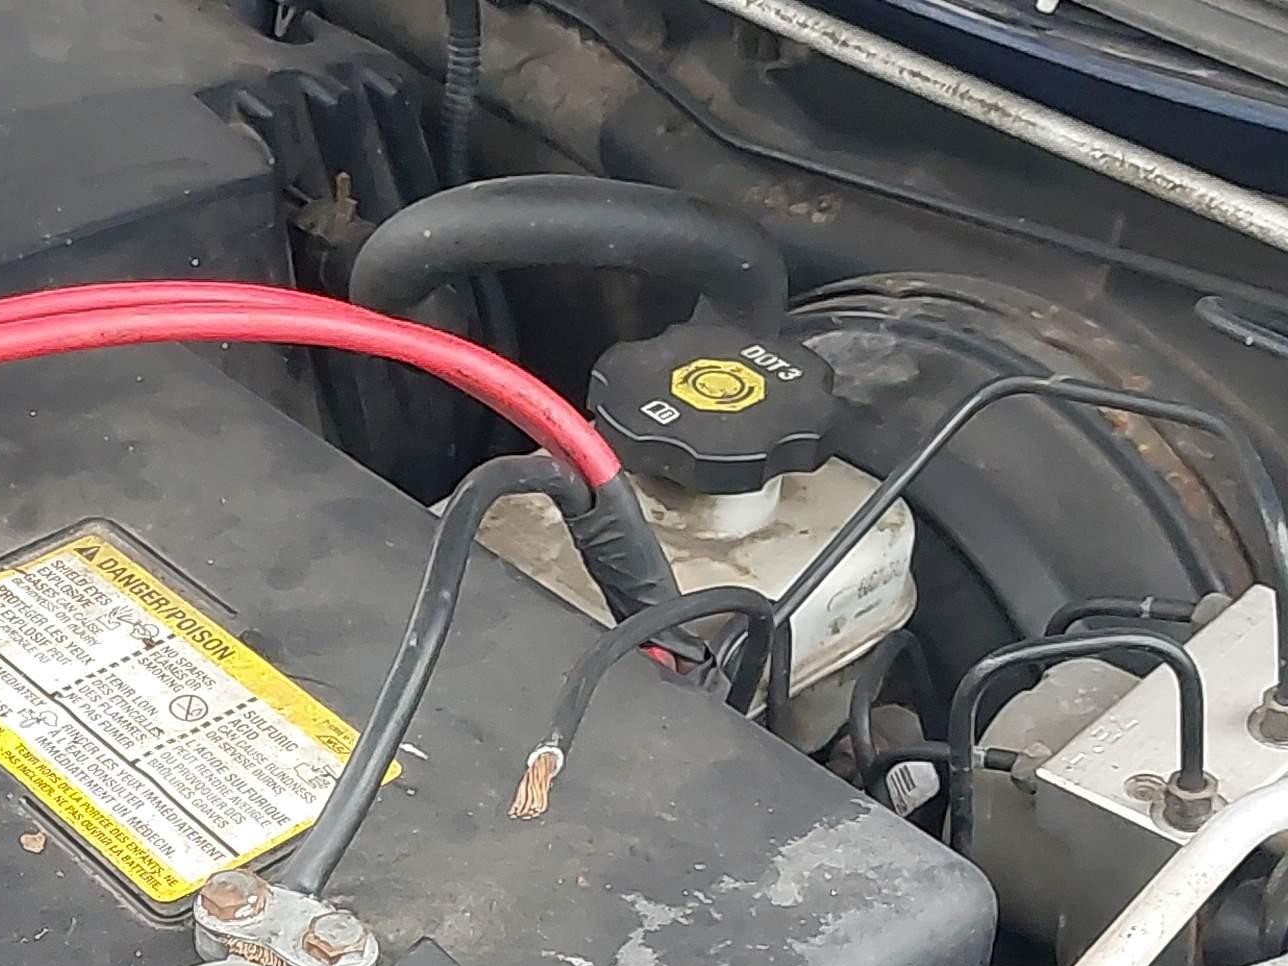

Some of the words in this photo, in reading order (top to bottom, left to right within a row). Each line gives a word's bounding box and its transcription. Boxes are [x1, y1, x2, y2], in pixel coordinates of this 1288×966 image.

[21, 572, 60, 599] GASES
[53, 596, 78, 614] CAN
[70, 611, 104, 635] CAUSE
[35, 565, 95, 610] EXPLOSIVE
[48, 558, 90, 587] SHIELD
[81, 584, 114, 606] EYES
[52, 610, 73, 624] OR
[94, 556, 238, 662] DANGER/POISON
[41, 623, 70, 644] LES
[61, 640, 97, 666] YEUX
[44, 646, 73, 666] PEUT
[158, 644, 180, 659] NO
[172, 655, 220, 690] SPARKS,
[76, 684, 103, 703] DES
[89, 677, 116, 696] DES
[135, 655, 186, 693] SMOKING
[146, 650, 190, 681] FLAMES
[182, 677, 204, 691] OR
[101, 672, 137, 698] TENIR
[130, 694, 161, 717] LOIN
[64, 691, 83, 705] NE
[76, 702, 104, 722] PAS
[96, 719, 137, 750] FUMER
[226, 716, 262, 742] ACID
[239, 708, 300, 753] SULFURIC
[182, 737, 232, 775] L'ACIDE
[220, 771, 293, 827] SULFURIQUE
[202, 729, 224, 744] OR
[248, 767, 288, 796] BURNS
[214, 723, 241, 742] CAN
[233, 738, 270, 765] CAUSE
[261, 761, 320, 805] BLINDNESS
[0, 749, 23, 766] PAS
[51, 794, 70, 807] NE
[63, 804, 86, 821] PAS
[107, 843, 126, 857] LA
[58, 722, 102, 756] RINCER
[94, 752, 120, 772] LES
[113, 768, 146, 792] YEUX
[136, 787, 229, 862] IMMÉDIATEMENT
[84, 761, 147, 811] CONSULTER
[157, 750, 179, 765] OU
[169, 762, 232, 811] PROVOQUER
[221, 806, 248, 826] DES
[170, 744, 200, 765] PEUT
[190, 762, 237, 798] RENDRE
[226, 792, 274, 829] AVEUGLE
[11, 742, 42, 765] TENIR
[55, 781, 74, 795] DE
[67, 791, 85, 804] LA
[107, 826, 130, 844] DES
[161, 873, 180, 888] NE
[109, 801, 133, 818] UN
[188, 796, 232, 830] GRAVES
